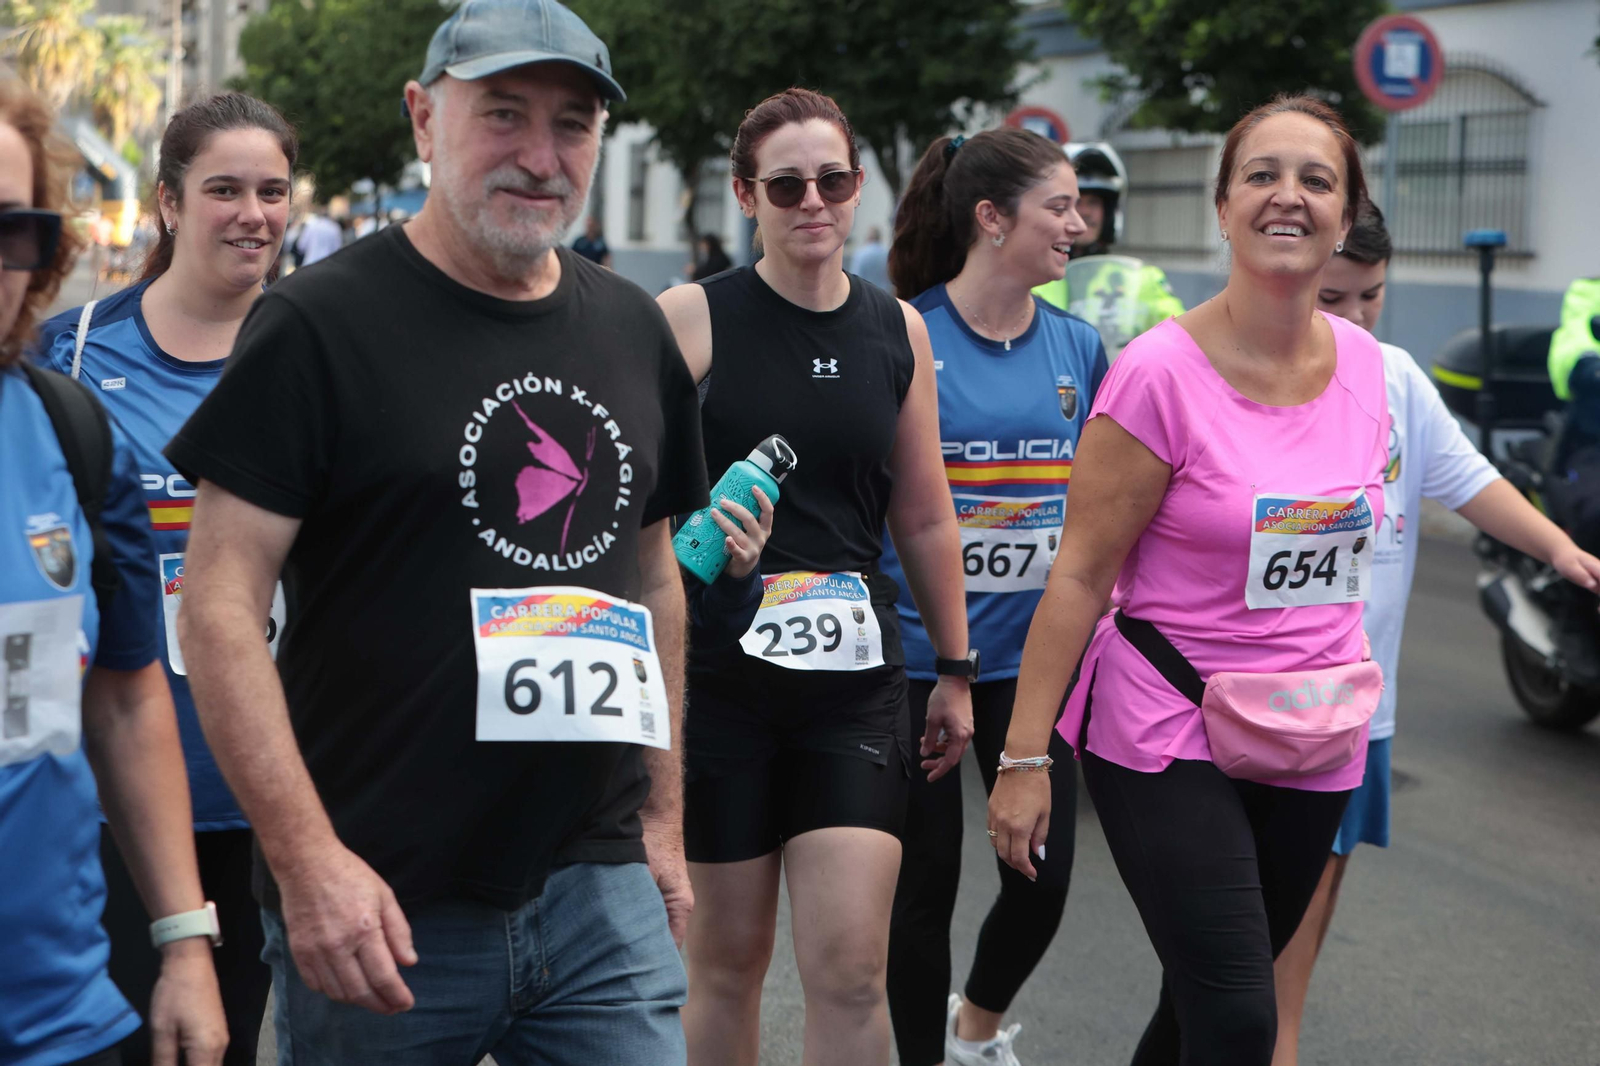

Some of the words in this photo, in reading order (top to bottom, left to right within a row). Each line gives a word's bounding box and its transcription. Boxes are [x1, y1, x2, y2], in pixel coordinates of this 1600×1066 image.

[458, 371, 563, 509] ASOCIACIÓN
[570, 385, 633, 511] X-FRÁGIL
[960, 504, 1015, 518] CARRERA
[1018, 505, 1059, 518] POPULAR
[1015, 518, 1040, 527] SANTO
[1041, 517, 1062, 526] ANGEL
[1263, 520, 1326, 531] ASOCIACION
[1328, 521, 1355, 531] SANTO
[1266, 506, 1328, 520] CARRERA
[1331, 502, 1368, 520] POPULAR
[478, 528, 617, 572] ANDALUCÍA
[962, 541, 1038, 578] 667
[1262, 546, 1339, 591] 654
[762, 591, 804, 604] CIACION
[806, 588, 837, 598] SANTO
[838, 590, 865, 599] ANGEL
[764, 578, 802, 595] RERA
[805, 576, 855, 591] POPULAR
[490, 603, 577, 620] CARRERA
[581, 606, 640, 632] POPULAR
[489, 621, 578, 634] ASOCIACION
[580, 621, 619, 638] SANTO
[620, 630, 648, 648] ANGEL
[755, 613, 843, 657] 239
[504, 658, 624, 717] 612
[1268, 677, 1355, 712] adidas
